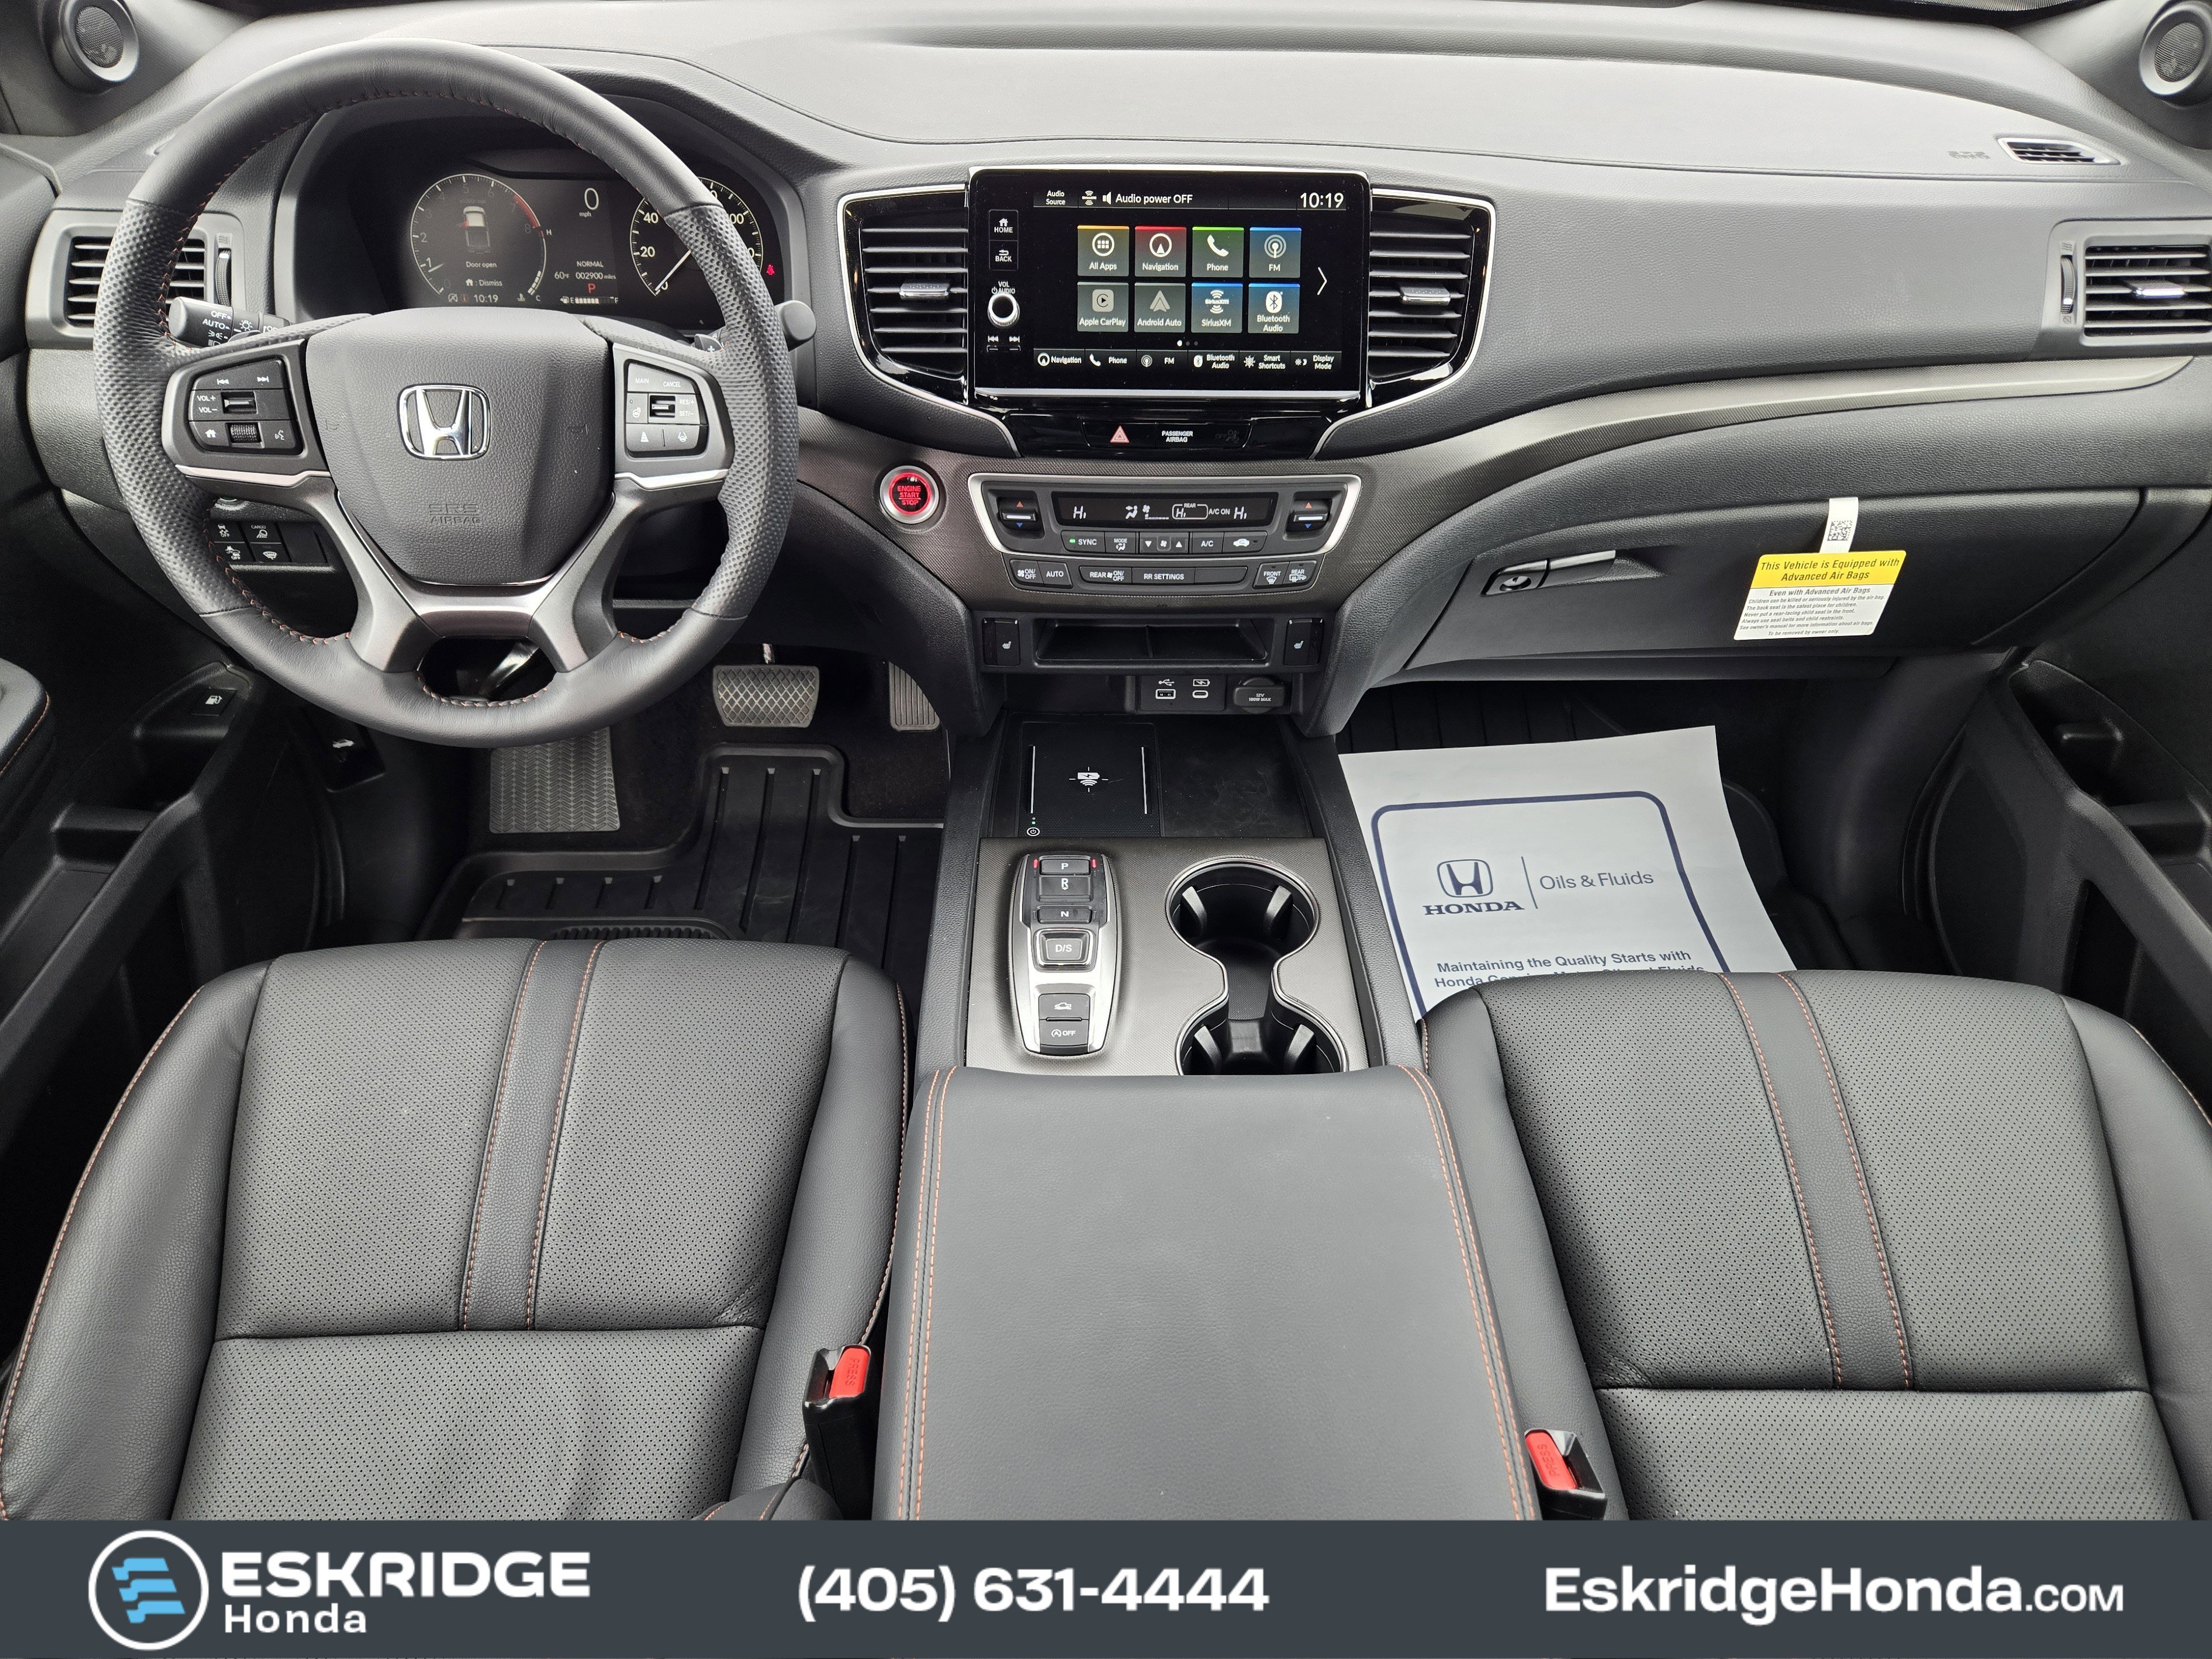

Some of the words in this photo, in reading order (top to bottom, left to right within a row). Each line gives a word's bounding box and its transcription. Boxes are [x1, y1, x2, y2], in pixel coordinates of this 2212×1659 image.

[585, 188, 599, 210] 0
[1115, 194, 1141, 204] Audio
[1144, 196, 1171, 205] power
[1173, 195, 1193, 204] OFF
[1300, 192, 1344, 208] 10:19
[643, 212, 659, 224] 40
[420, 232, 427, 243] 2
[640, 246, 656, 258] 20
[426, 258, 432, 268] 1
[1099, 262, 1117, 271] Apps
[1142, 263, 1178, 271] Navigation
[587, 283, 596, 294] P
[474, 294, 498, 303] 10:19
[211, 310, 227, 319] OFF
[202, 318, 226, 330] AUTO
[1079, 317, 1099, 326] Apple
[1100, 317, 1126, 327] CarPlay
[1201, 319, 1232, 327] SiriusXM
[1051, 356, 1082, 364] Navigation
[1313, 355, 1334, 363] Display
[1761, 562, 1780, 570] This
[1784, 561, 1818, 570] Vehicle
[1821, 560, 1829, 568] is
[1833, 559, 1877, 570] Equipped
[1880, 558, 1900, 566] with
[1781, 572, 1828, 581] Advanced
[1829, 571, 1844, 580] Air
[1846, 571, 1870, 580] Bags
[1061, 878, 1068, 888] R
[1540, 876, 1577, 889] Oils
[1580, 875, 1597, 888] &
[1598, 871, 1654, 886] Fluids
[1422, 901, 1525, 916] HONDA
[1056, 944, 1072, 953] D/S
[1437, 959, 1524, 973] Maintaining
[1527, 958, 1552, 968] the
[1555, 955, 1606, 967] Quality
[1611, 953, 1656, 963] Starts
[1659, 951, 1692, 961] with
[1434, 976, 1483, 987] Honda
[1537, 1443, 1560, 1477] PRESS
